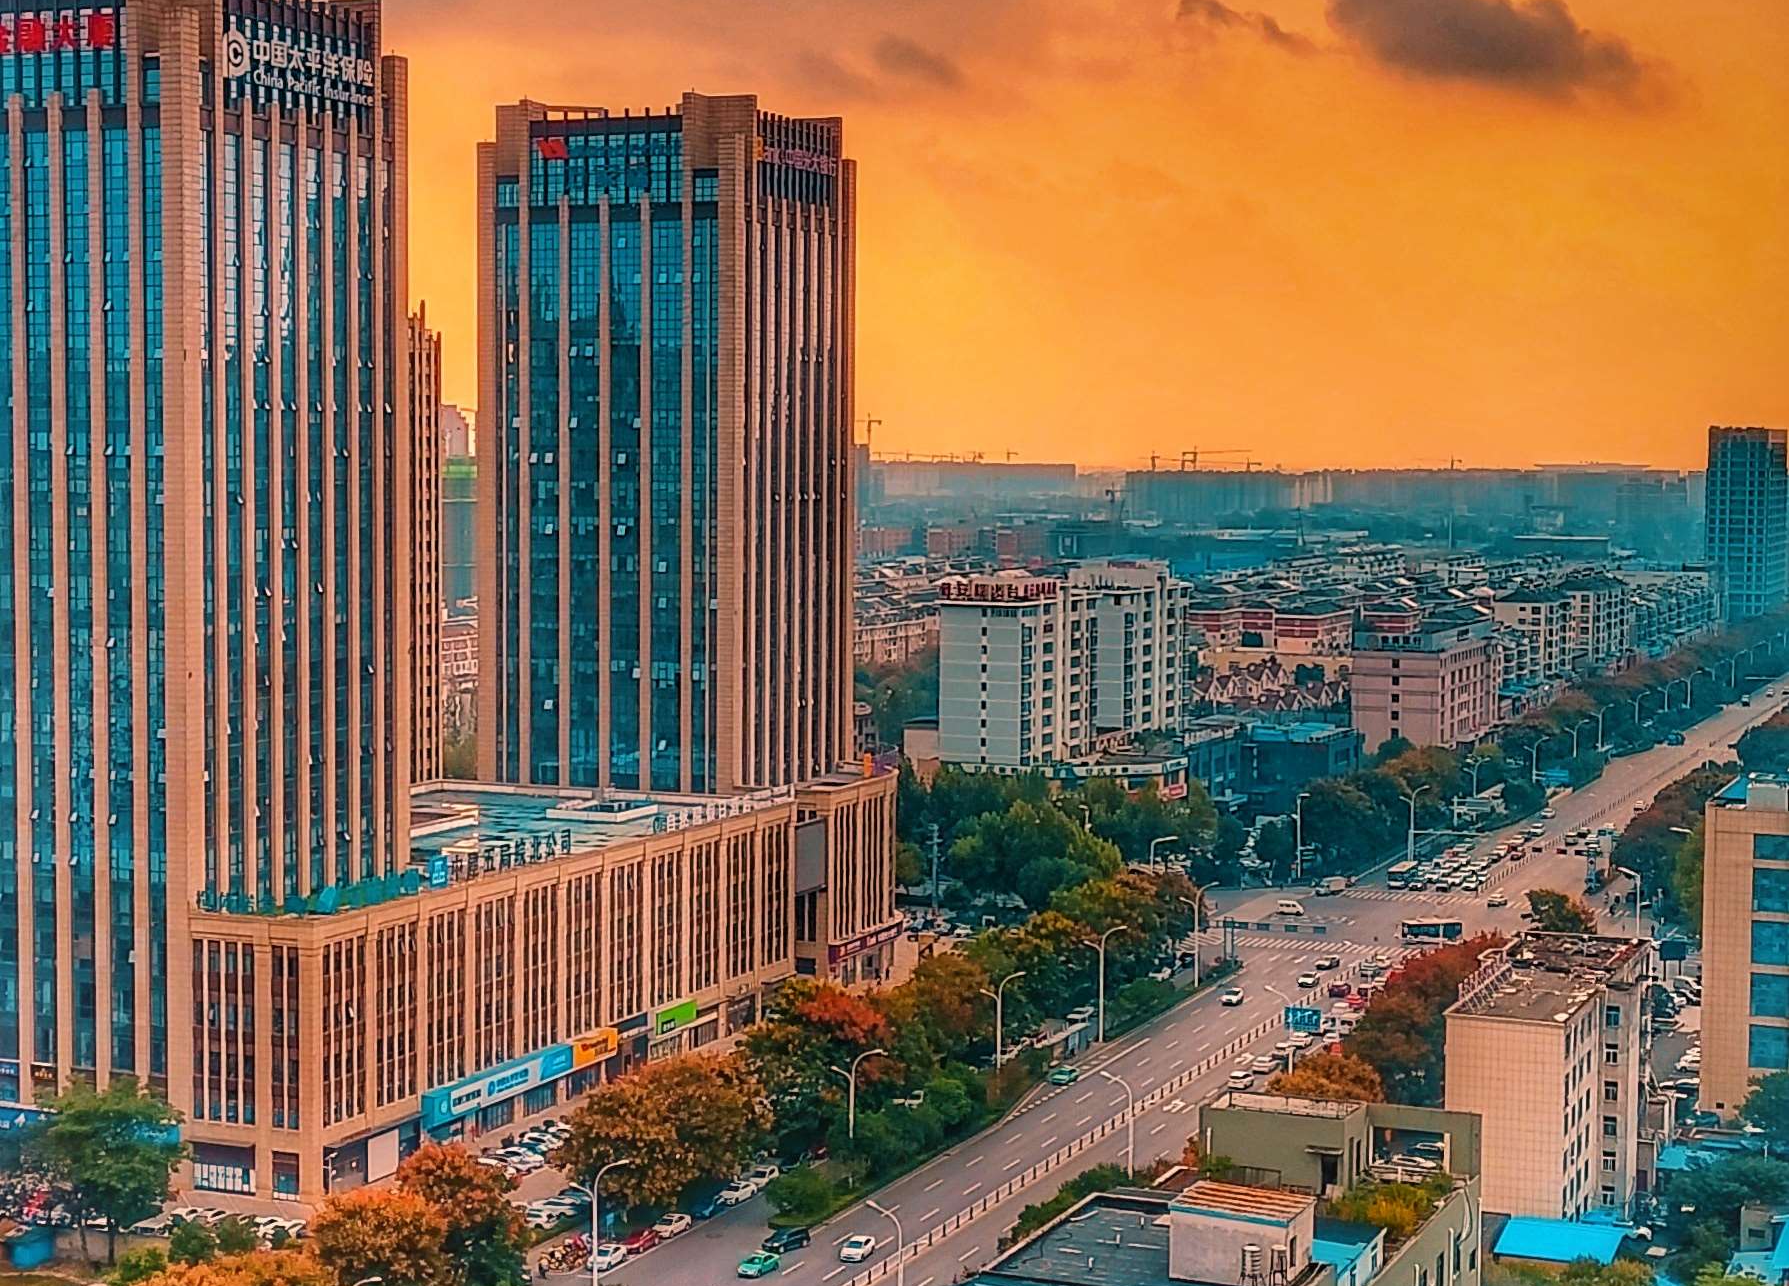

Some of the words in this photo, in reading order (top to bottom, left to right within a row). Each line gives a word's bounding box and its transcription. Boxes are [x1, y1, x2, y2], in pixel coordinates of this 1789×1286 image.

[252, 39, 374, 88] 中国太平洋保险
[253, 68, 284, 90] China
[287, 76, 322, 97] Pacific
[324, 82, 375, 107] Insurance
